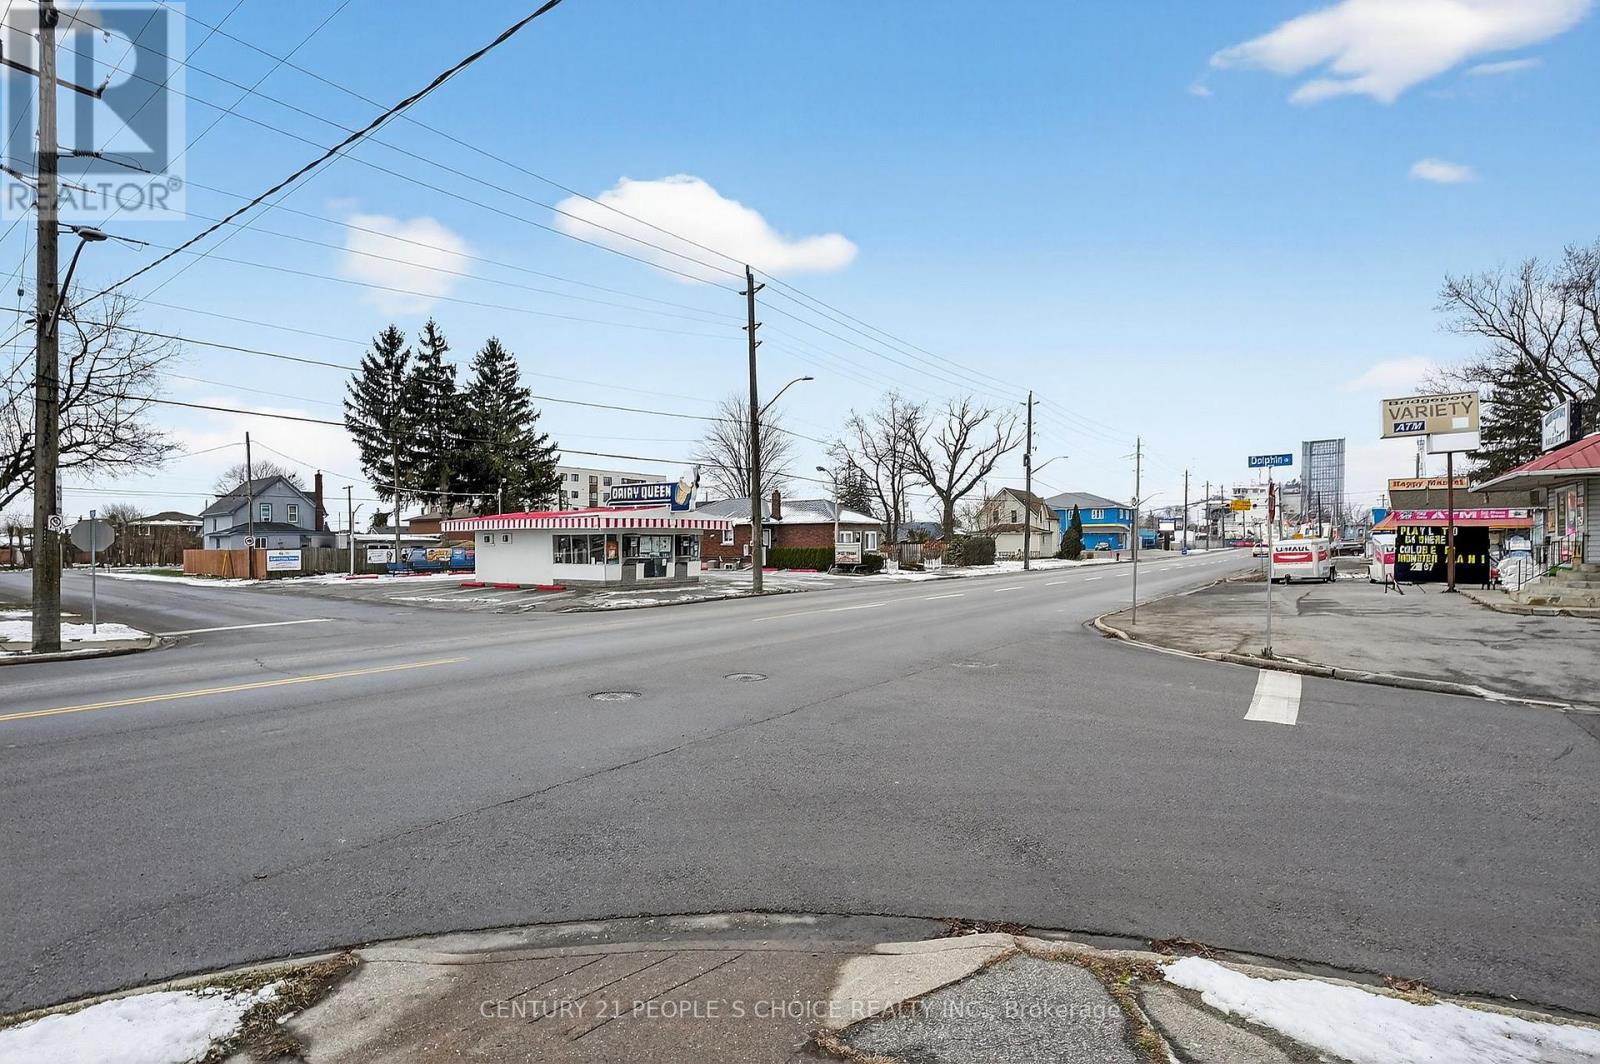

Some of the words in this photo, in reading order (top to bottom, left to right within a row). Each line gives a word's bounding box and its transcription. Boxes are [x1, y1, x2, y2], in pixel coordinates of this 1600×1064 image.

[1389, 394, 1472, 406] Bridgeport
[1389, 401, 1473, 420] VARIETY
[1396, 422, 1423, 432] ATM
[1251, 455, 1283, 467] Dolphin
[1392, 479, 1424, 488] Happy
[1427, 478, 1465, 487] Maret
[612, 487, 639, 500] DAIRY
[641, 485, 671, 500] QUEEN
